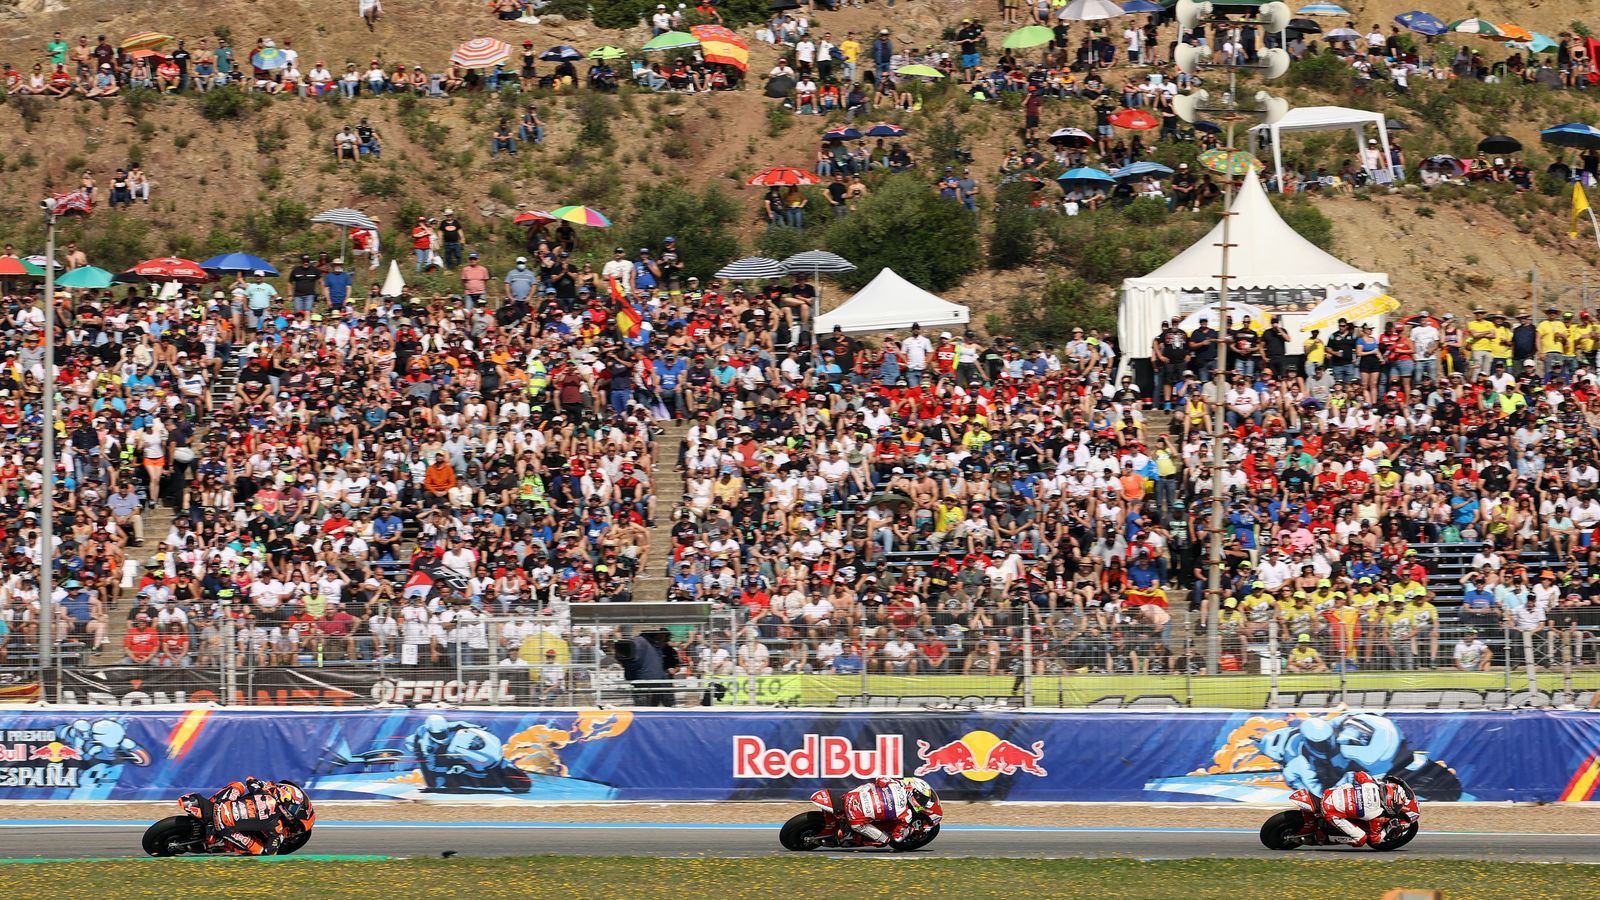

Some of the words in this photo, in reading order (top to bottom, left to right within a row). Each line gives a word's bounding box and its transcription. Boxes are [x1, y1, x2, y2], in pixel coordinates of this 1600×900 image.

[371, 679, 516, 702] OFFICIAL
[7, 730, 56, 741] PREMIO
[0, 743, 27, 761] Bull
[733, 734, 819, 778] Red
[820, 735, 904, 779] Bull
[0, 762, 79, 787] ESPAÑA
